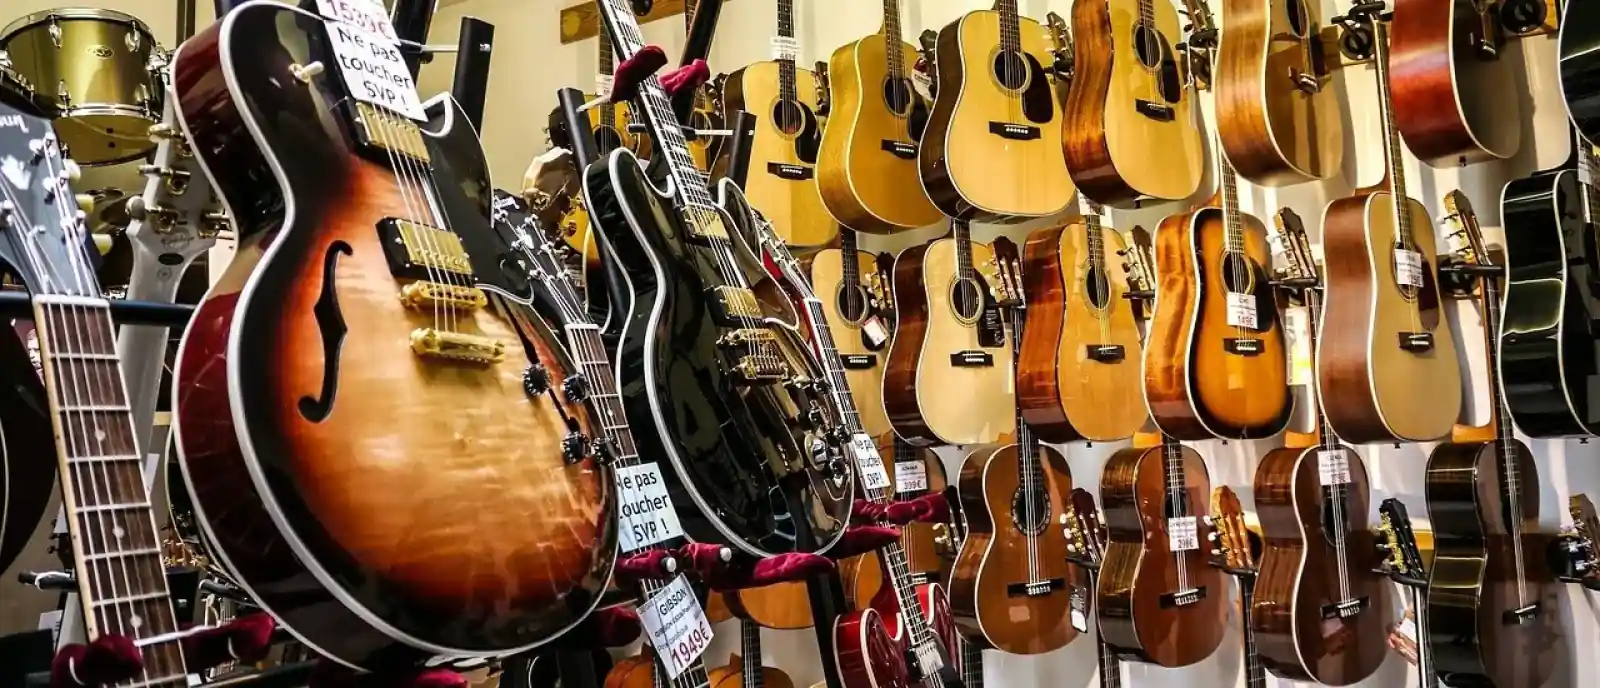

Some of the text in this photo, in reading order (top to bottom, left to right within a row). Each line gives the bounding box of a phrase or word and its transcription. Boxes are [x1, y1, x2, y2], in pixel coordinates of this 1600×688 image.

[337, 26, 399, 62] Ne pas
[340, 53, 410, 89] toucher
[634, 472, 657, 491] pas
[633, 521, 657, 542] SVP
[660, 588, 687, 616] GIBSON
[671, 621, 709, 668] 1949€
